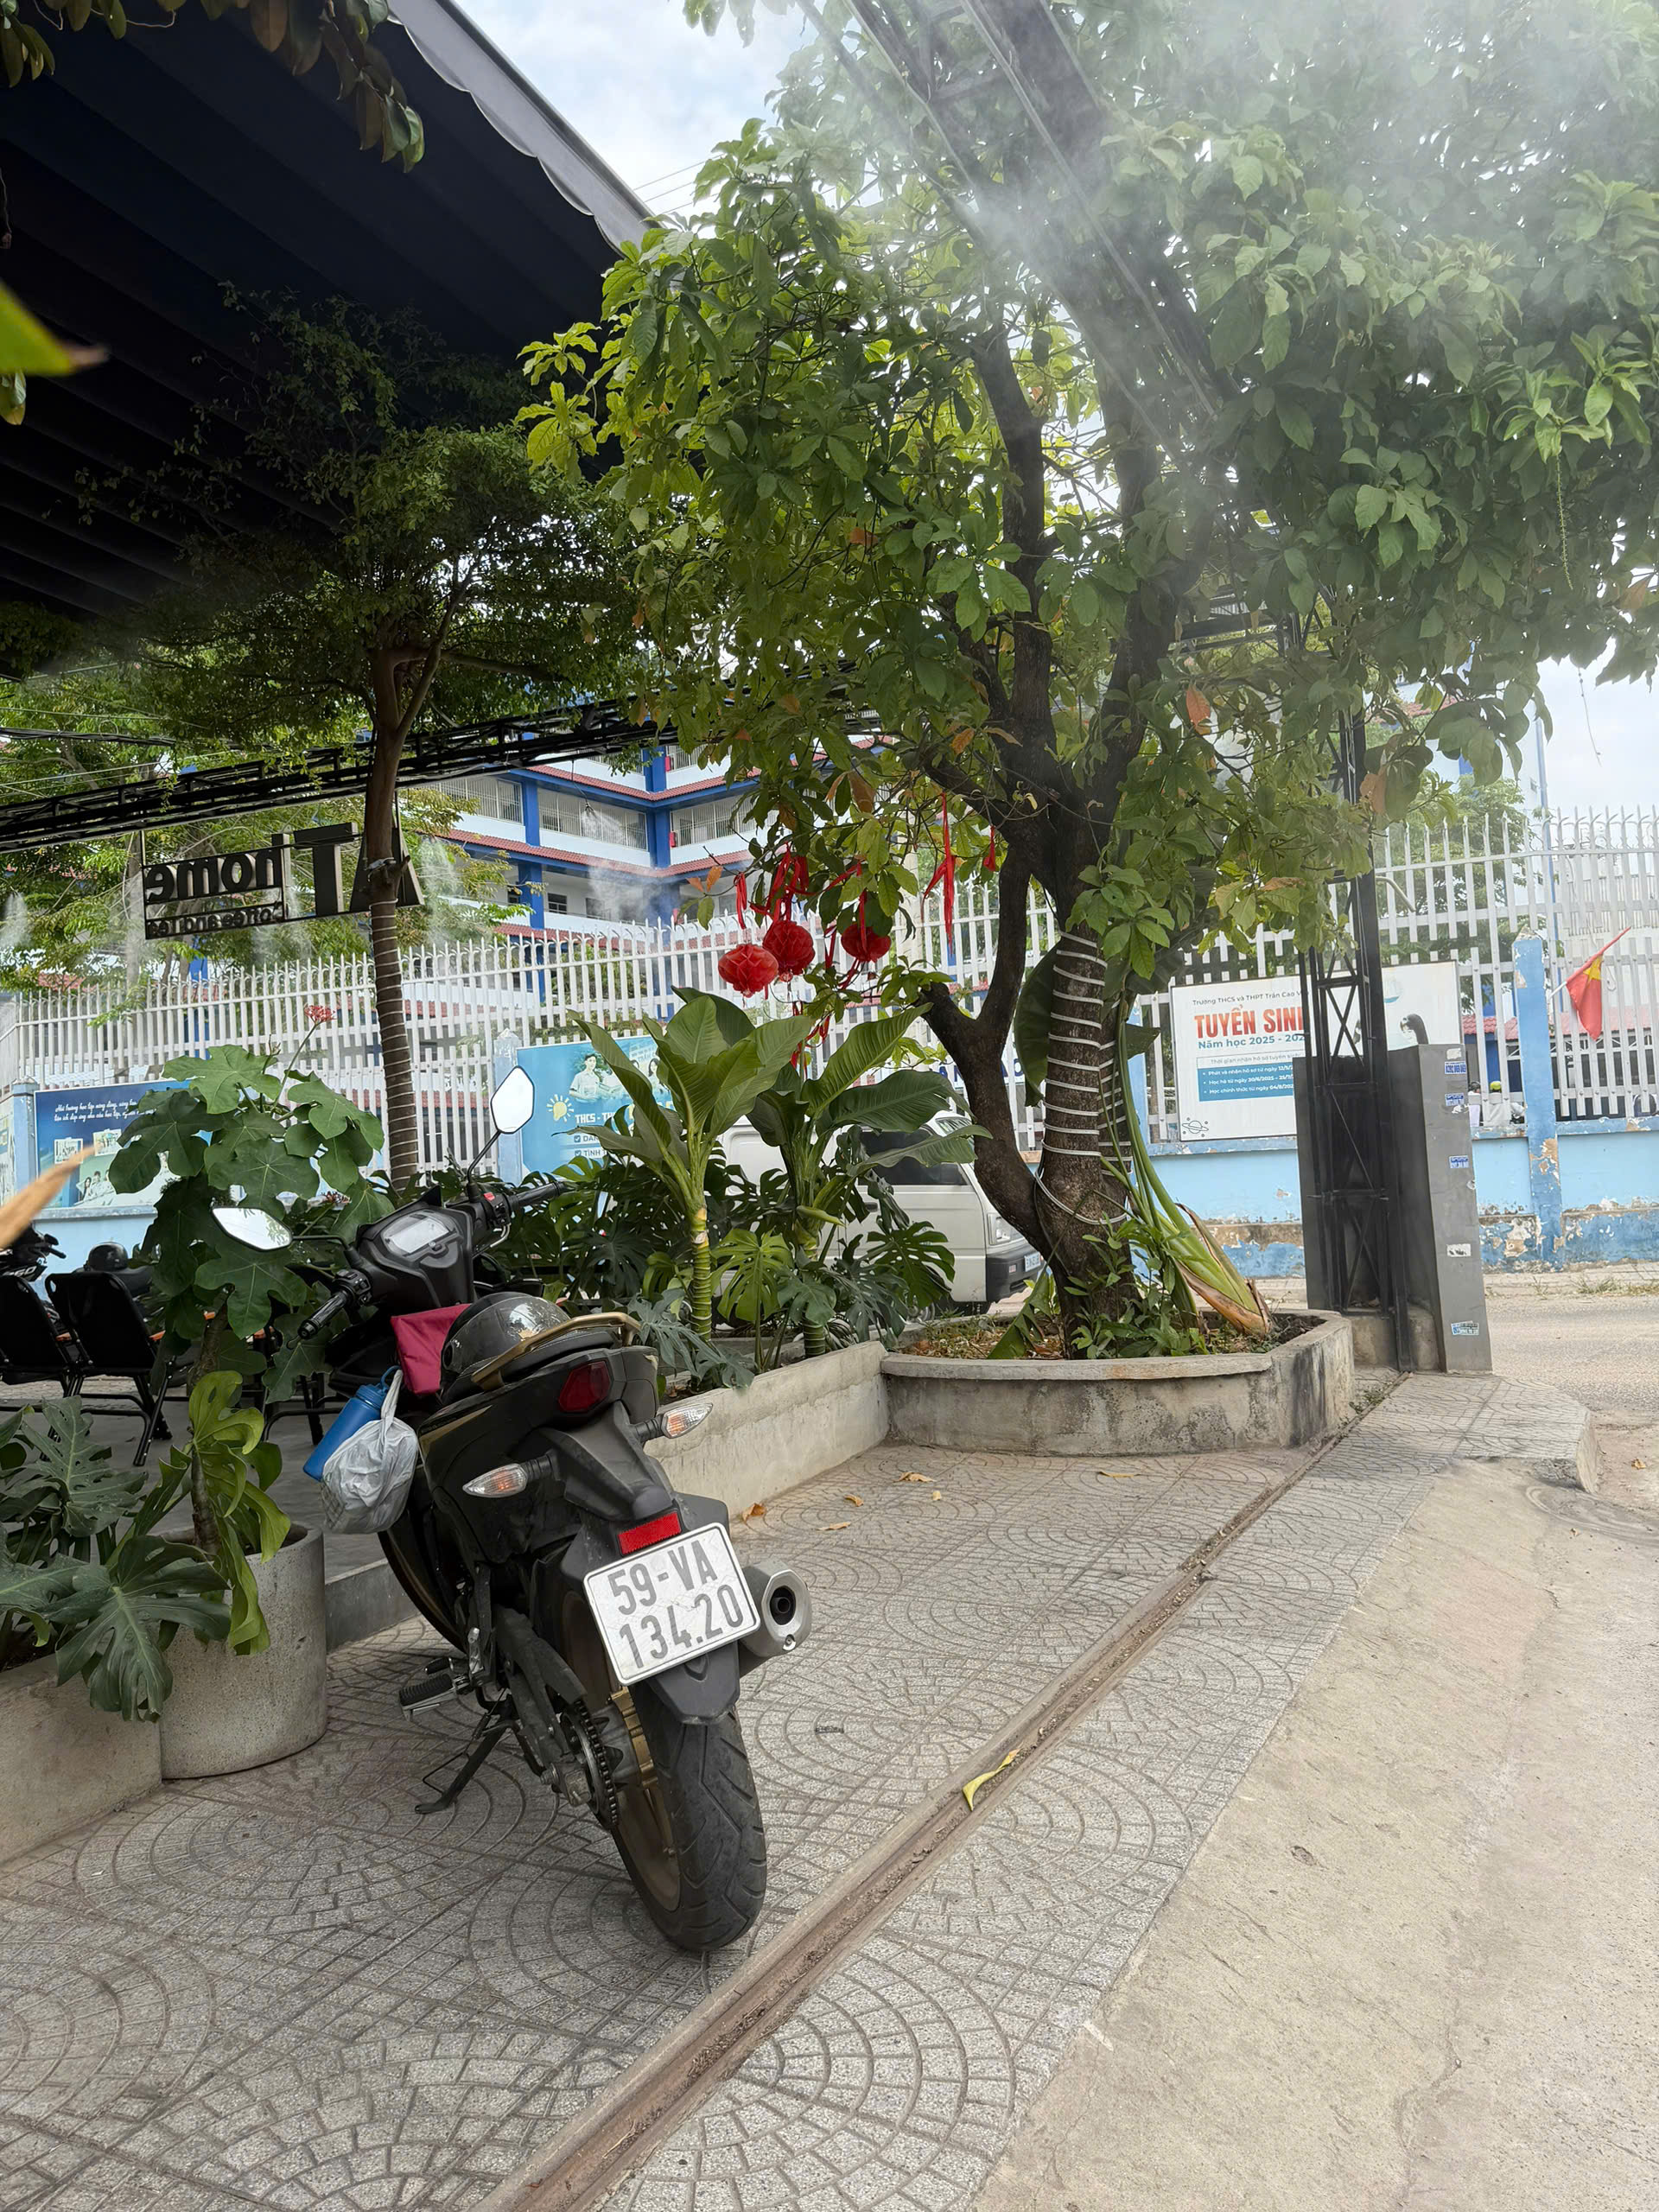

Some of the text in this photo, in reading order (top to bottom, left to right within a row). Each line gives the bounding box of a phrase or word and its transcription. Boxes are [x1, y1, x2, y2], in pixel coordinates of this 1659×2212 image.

[1194, 1004, 1256, 1039] TUYỂN
[1198, 1040, 1223, 1049] Năm
[1227, 1039, 1247, 1048] học
[1249, 1035, 1274, 1045] 2025
[575, 1113, 595, 1123] THCS
[607, 1540, 718, 1615] 59-VA
[619, 1584, 744, 1669] 134.20
